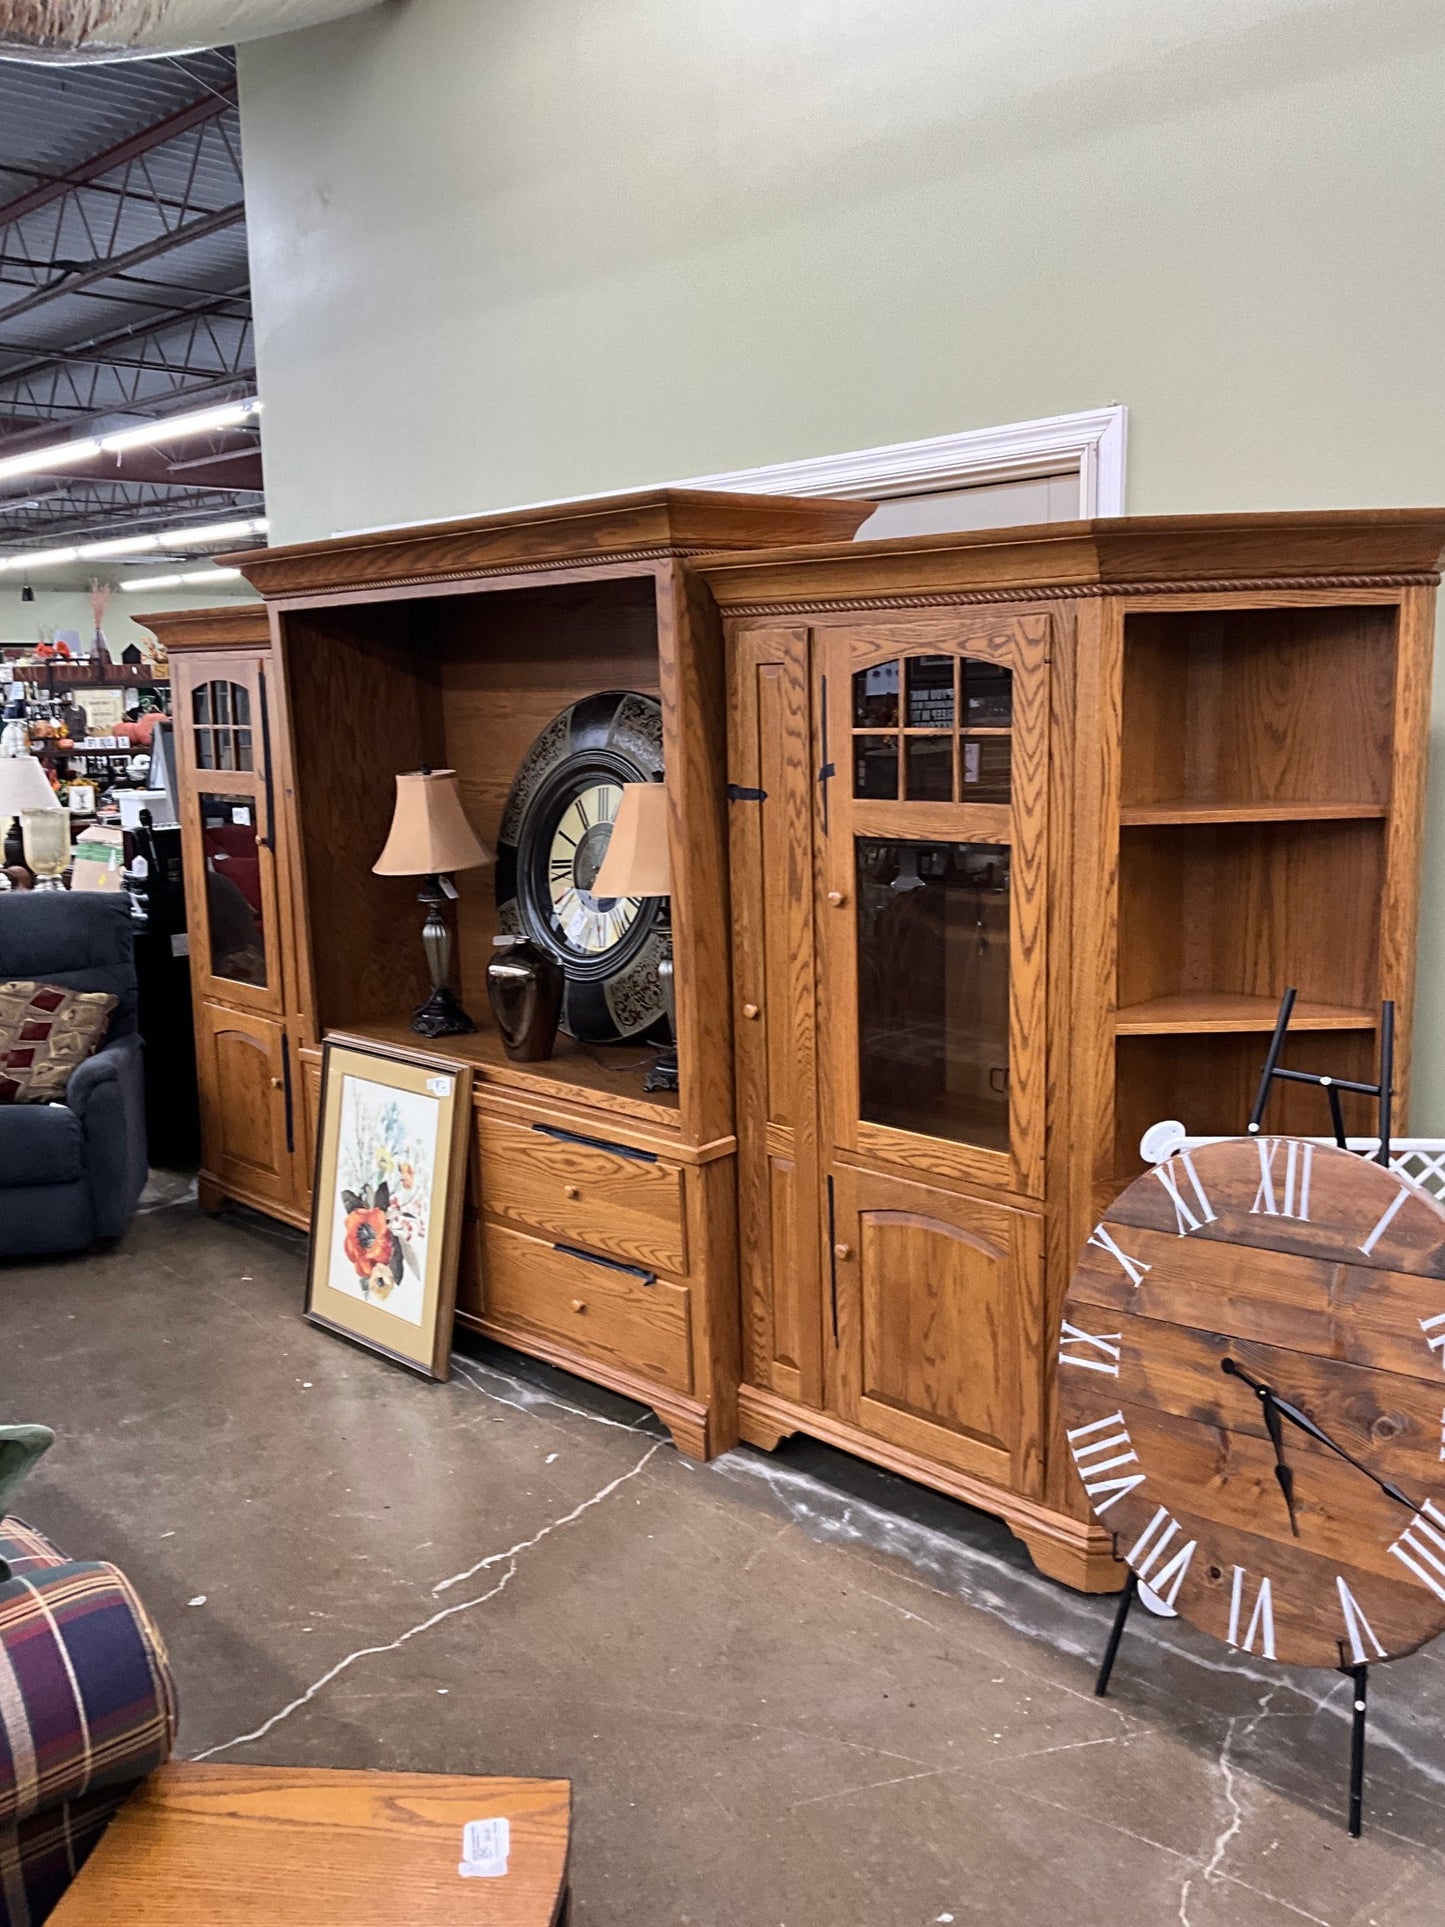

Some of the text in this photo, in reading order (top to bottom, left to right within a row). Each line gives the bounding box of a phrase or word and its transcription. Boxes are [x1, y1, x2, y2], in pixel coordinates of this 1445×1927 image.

[558, 830, 577, 847] I
[575, 799, 590, 830] II
[551, 860, 572, 882] XII
[1151, 1151, 1218, 1238] XI
[1249, 1138, 1316, 1222] XII
[1086, 1222, 1152, 1288] X
[1357, 1184, 1412, 1257] I
[1058, 1319, 1122, 1378] IX
[1066, 1410, 1146, 1516] VIII
[1124, 1504, 1197, 1609] VII
[1226, 1564, 1277, 1660] VI
[1336, 1575, 1388, 1664] V
